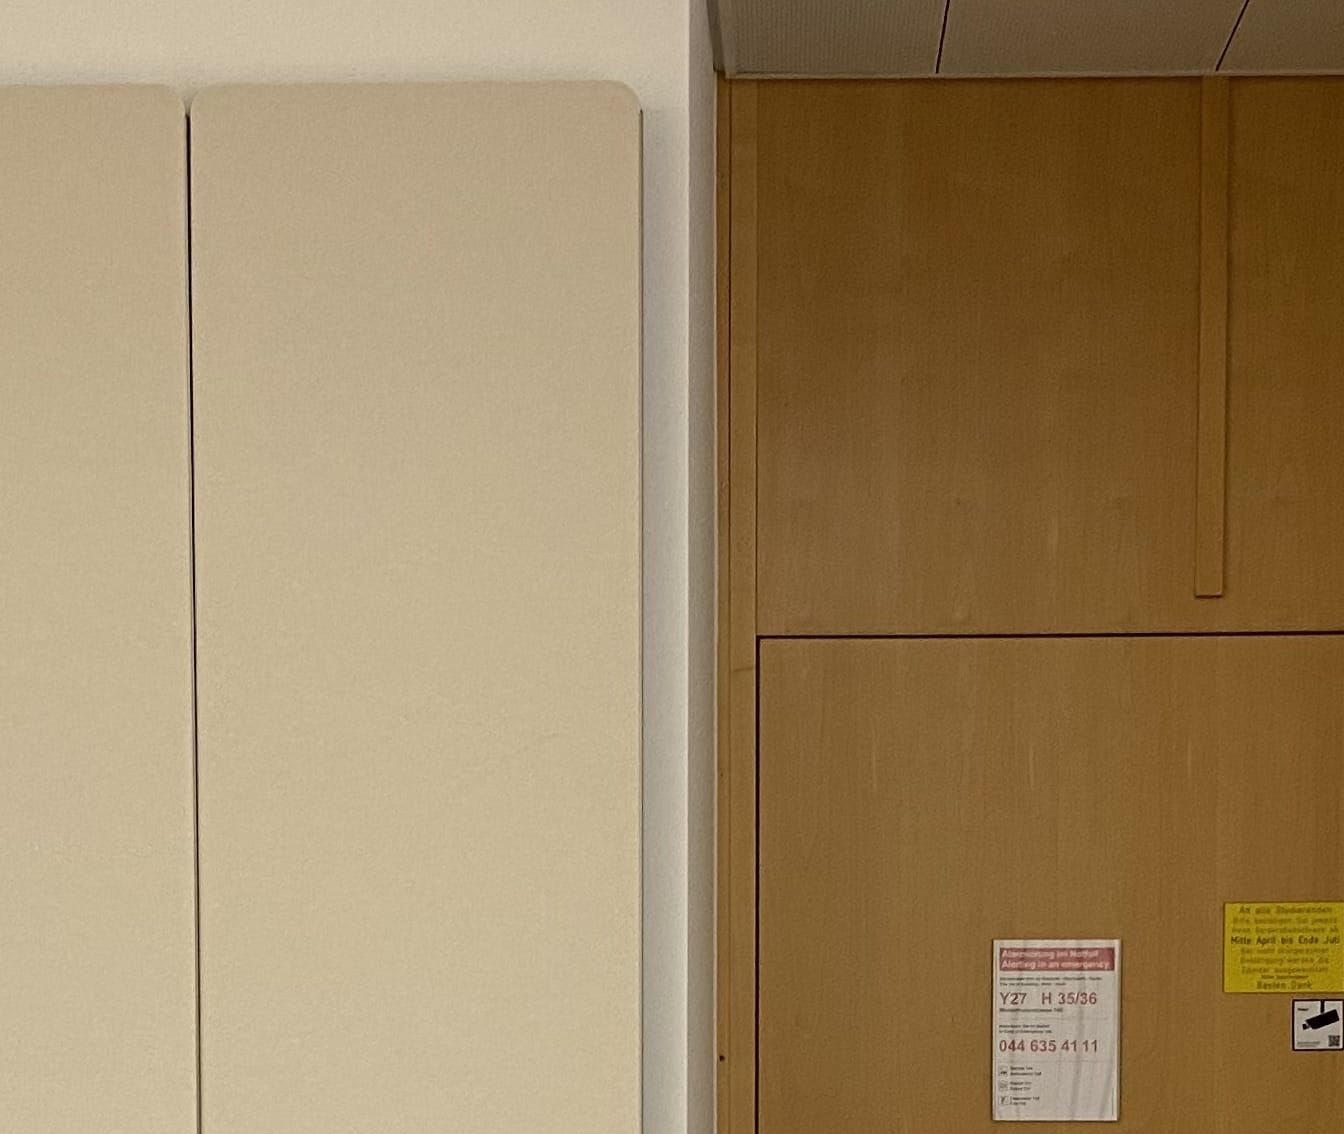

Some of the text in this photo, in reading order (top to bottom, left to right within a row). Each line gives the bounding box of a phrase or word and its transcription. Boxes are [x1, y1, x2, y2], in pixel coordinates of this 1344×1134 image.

[1230, 935, 1251, 945] Mitte
[1256, 935, 1277, 946] April
[1280, 935, 1294, 945] bis
[1297, 935, 1319, 945] Ende
[999, 991, 1098, 1005] Y27 H 35/36
[999, 1039, 1098, 1052] 044 635 41 11
